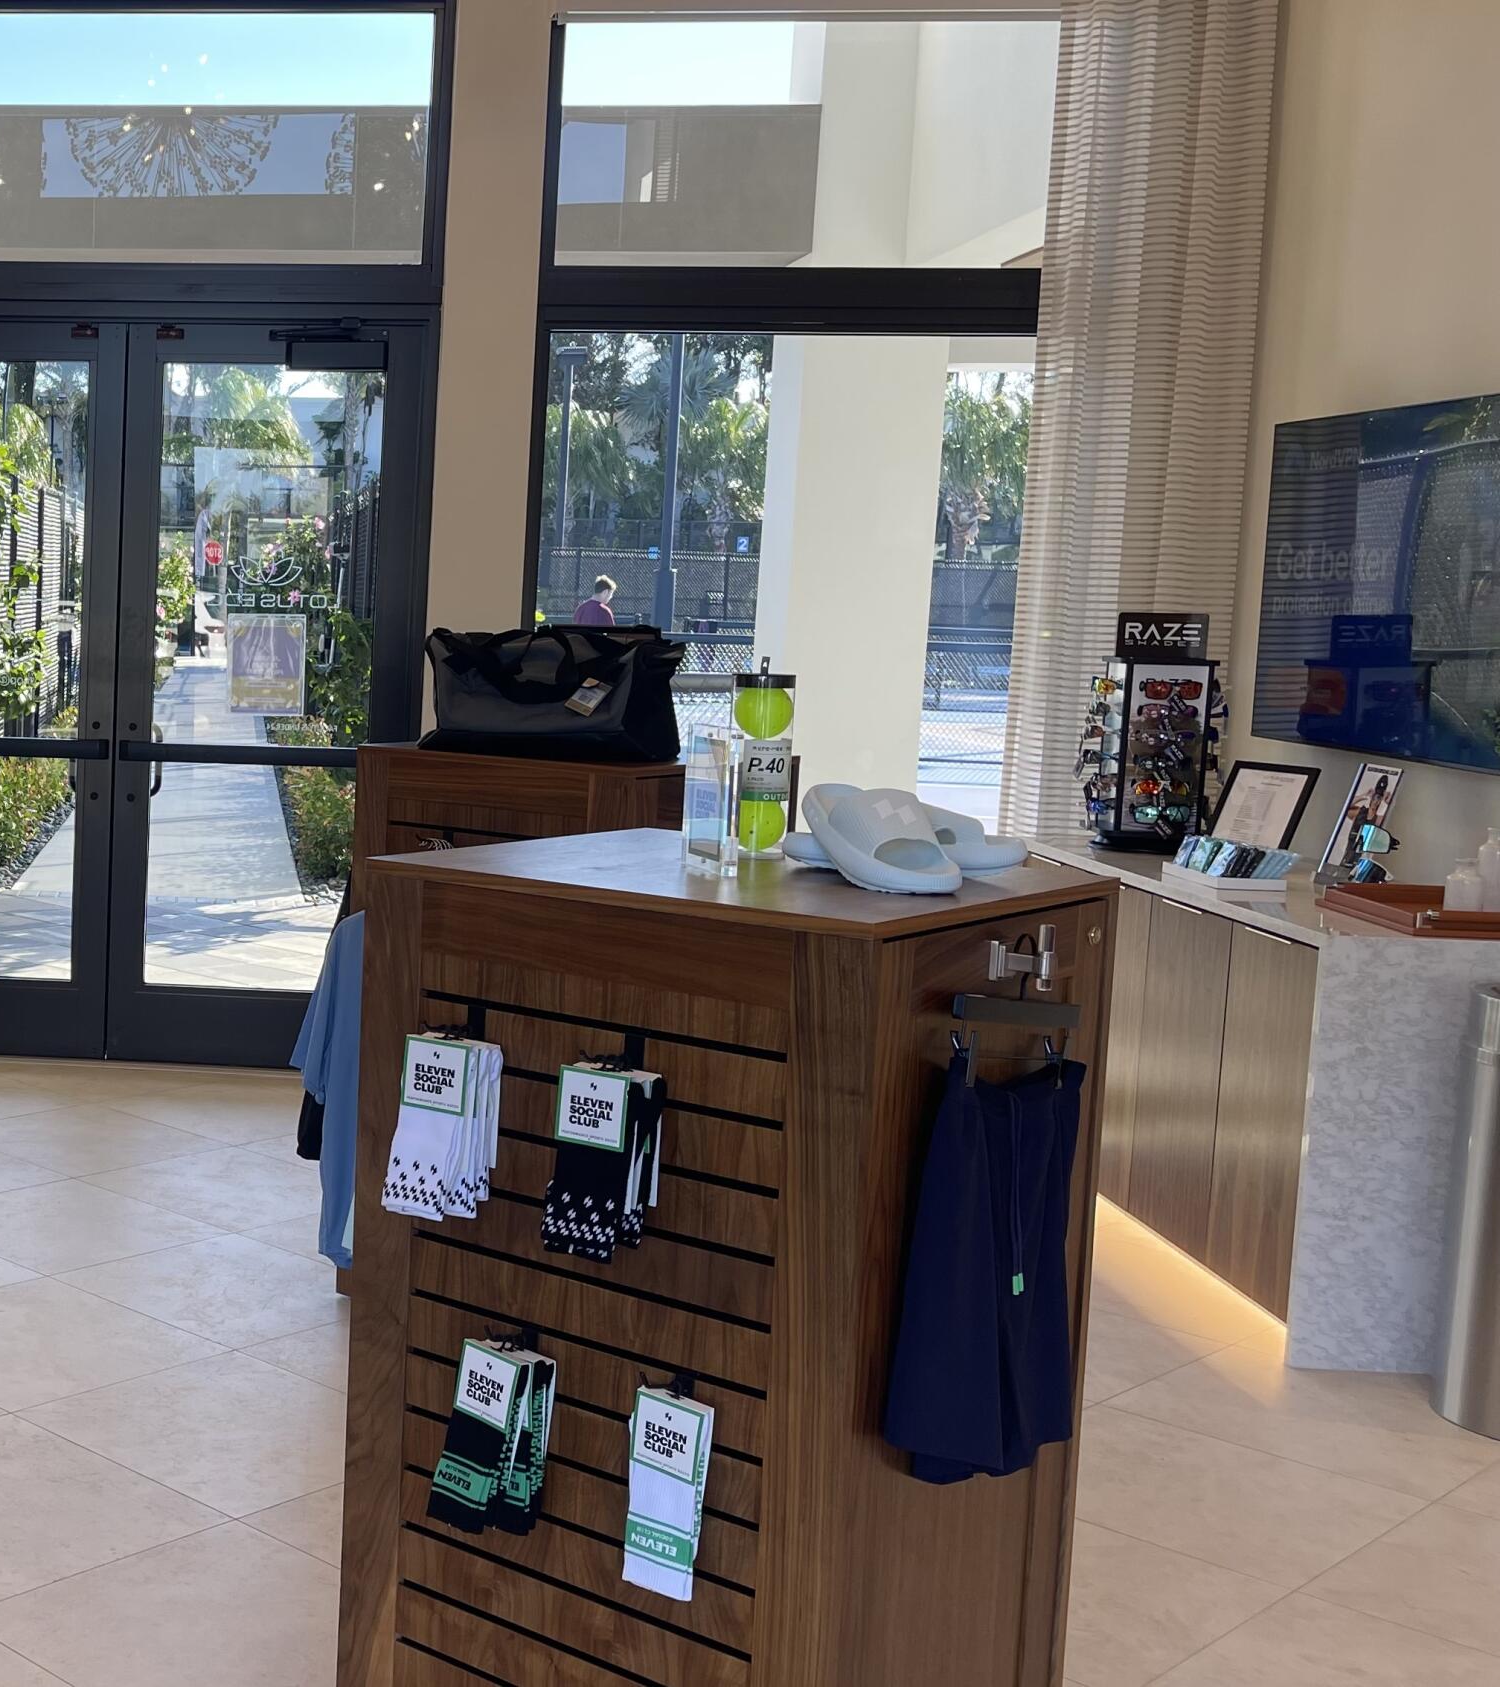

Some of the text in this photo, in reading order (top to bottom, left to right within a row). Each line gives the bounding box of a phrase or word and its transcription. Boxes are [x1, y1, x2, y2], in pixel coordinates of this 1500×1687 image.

[738, 538, 748, 550] 2
[1276, 540, 1392, 582] Get better
[1124, 622, 1202, 641] RAZE
[1124, 640, 1200, 648] SHADES
[414, 1063, 456, 1078] ELEVEN
[414, 1073, 454, 1088] SOCIAL
[414, 1082, 442, 1095] CLUB
[570, 1094, 614, 1112] ELEVEN
[568, 1115, 600, 1128] CLUB
[570, 1105, 612, 1121] SOCIAL
[468, 1369, 504, 1394] ELEVEN
[466, 1388, 491, 1406] CLUB
[467, 1379, 502, 1403] SOCIAL
[645, 1420, 688, 1445] ELEVEN
[644, 1430, 686, 1454] SOCIAL
[644, 1440, 673, 1458] CLUB
[438, 1470, 472, 1491] ELEVEN
[630, 1532, 678, 1557] ELEVEN
